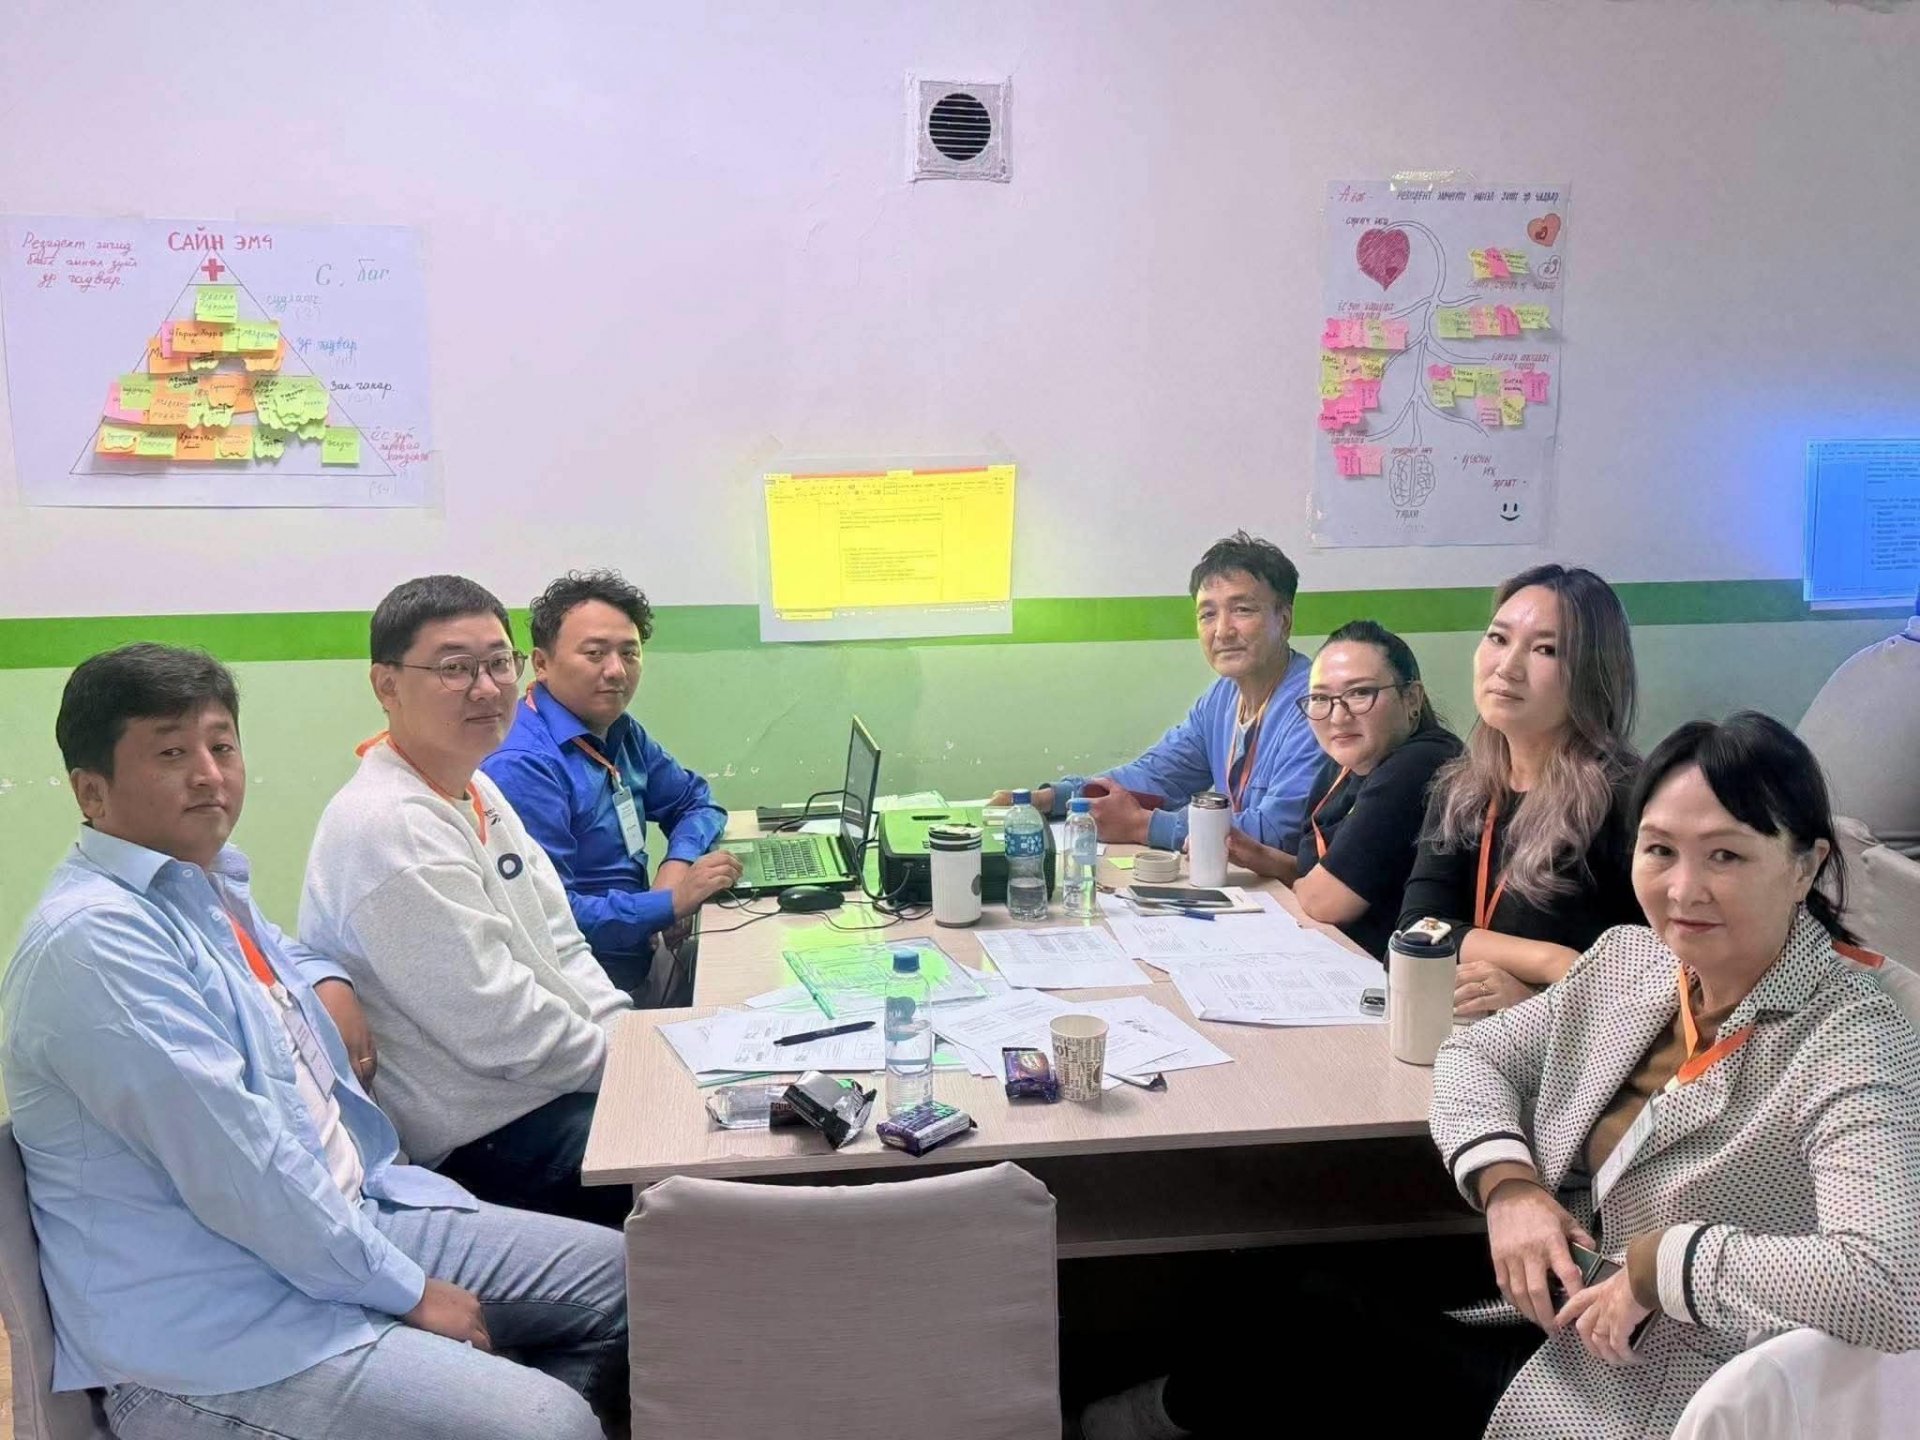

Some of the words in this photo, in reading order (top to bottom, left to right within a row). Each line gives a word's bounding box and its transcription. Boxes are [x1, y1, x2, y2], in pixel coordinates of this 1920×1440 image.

[167, 226, 224, 251] САЙН
[233, 233, 273, 251] ЭМЧ
[330, 380, 352, 392] Зан
